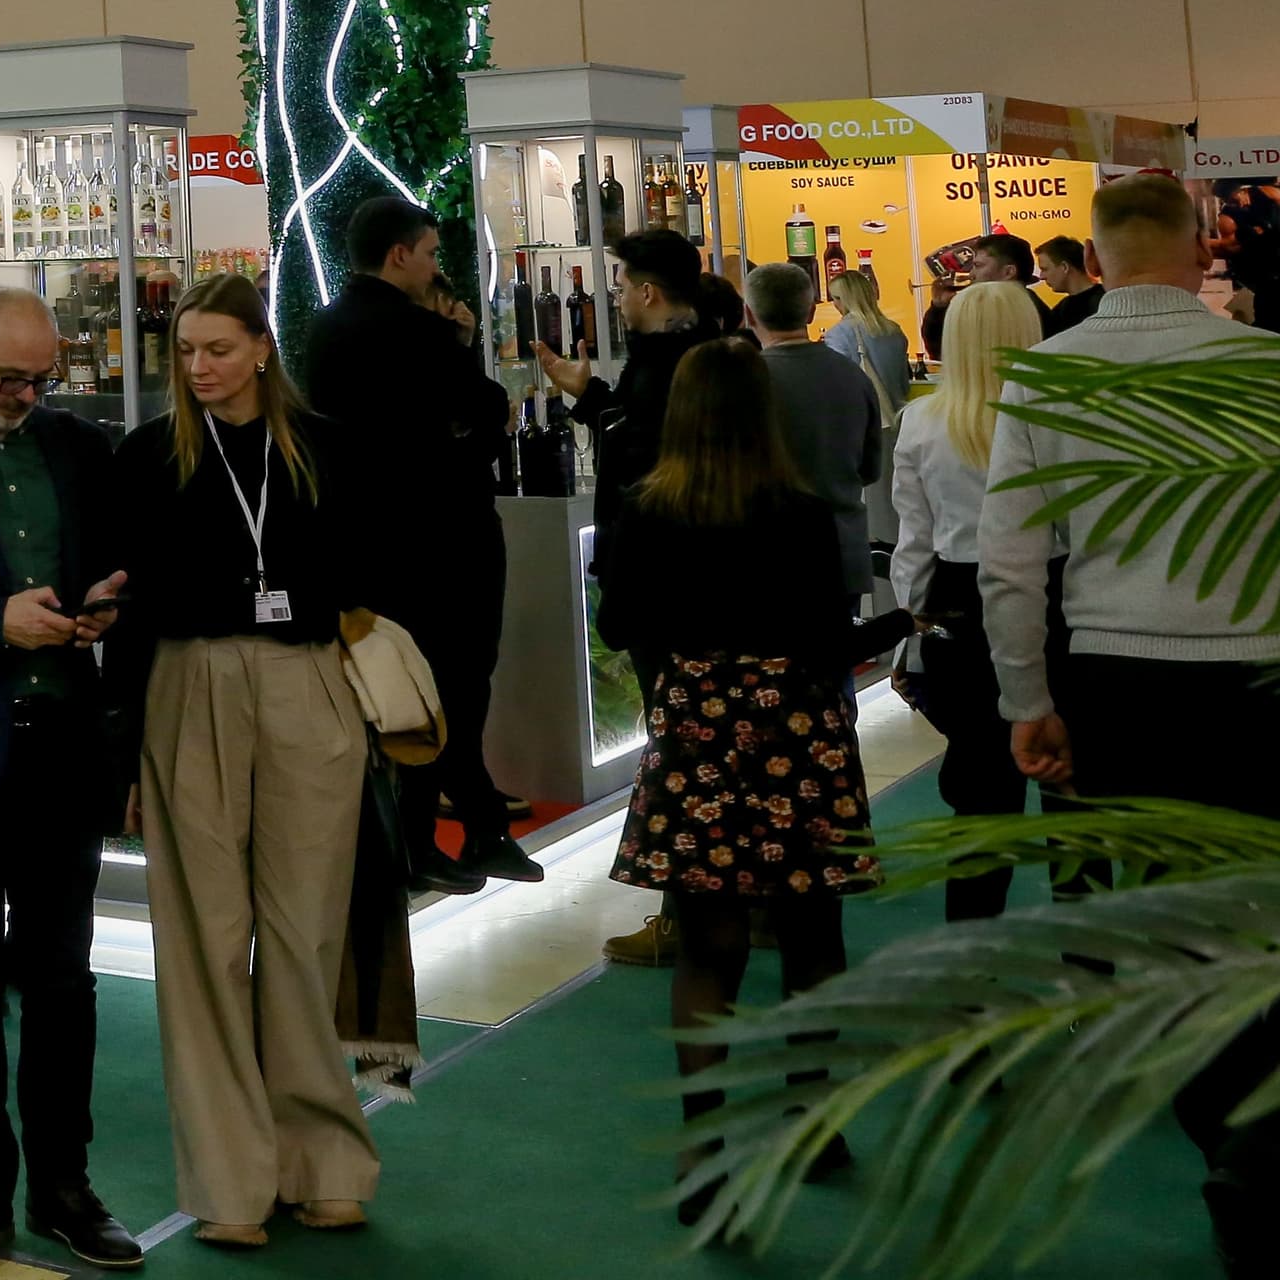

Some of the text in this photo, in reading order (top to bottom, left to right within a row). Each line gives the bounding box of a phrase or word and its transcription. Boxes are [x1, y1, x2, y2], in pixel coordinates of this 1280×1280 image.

[943, 96, 973, 106] 23D83
[762, 123, 823, 141] FOOD
[829, 118, 915, 140] CO.,LTD
[813, 158, 849, 170] соус
[853, 156, 896, 169] суши
[1194, 151, 1233, 168] Co.,
[791, 176, 855, 189] SOY SAUCE
[994, 178, 1068, 198] SAUCE
[1010, 209, 1071, 220] NON-GMO
